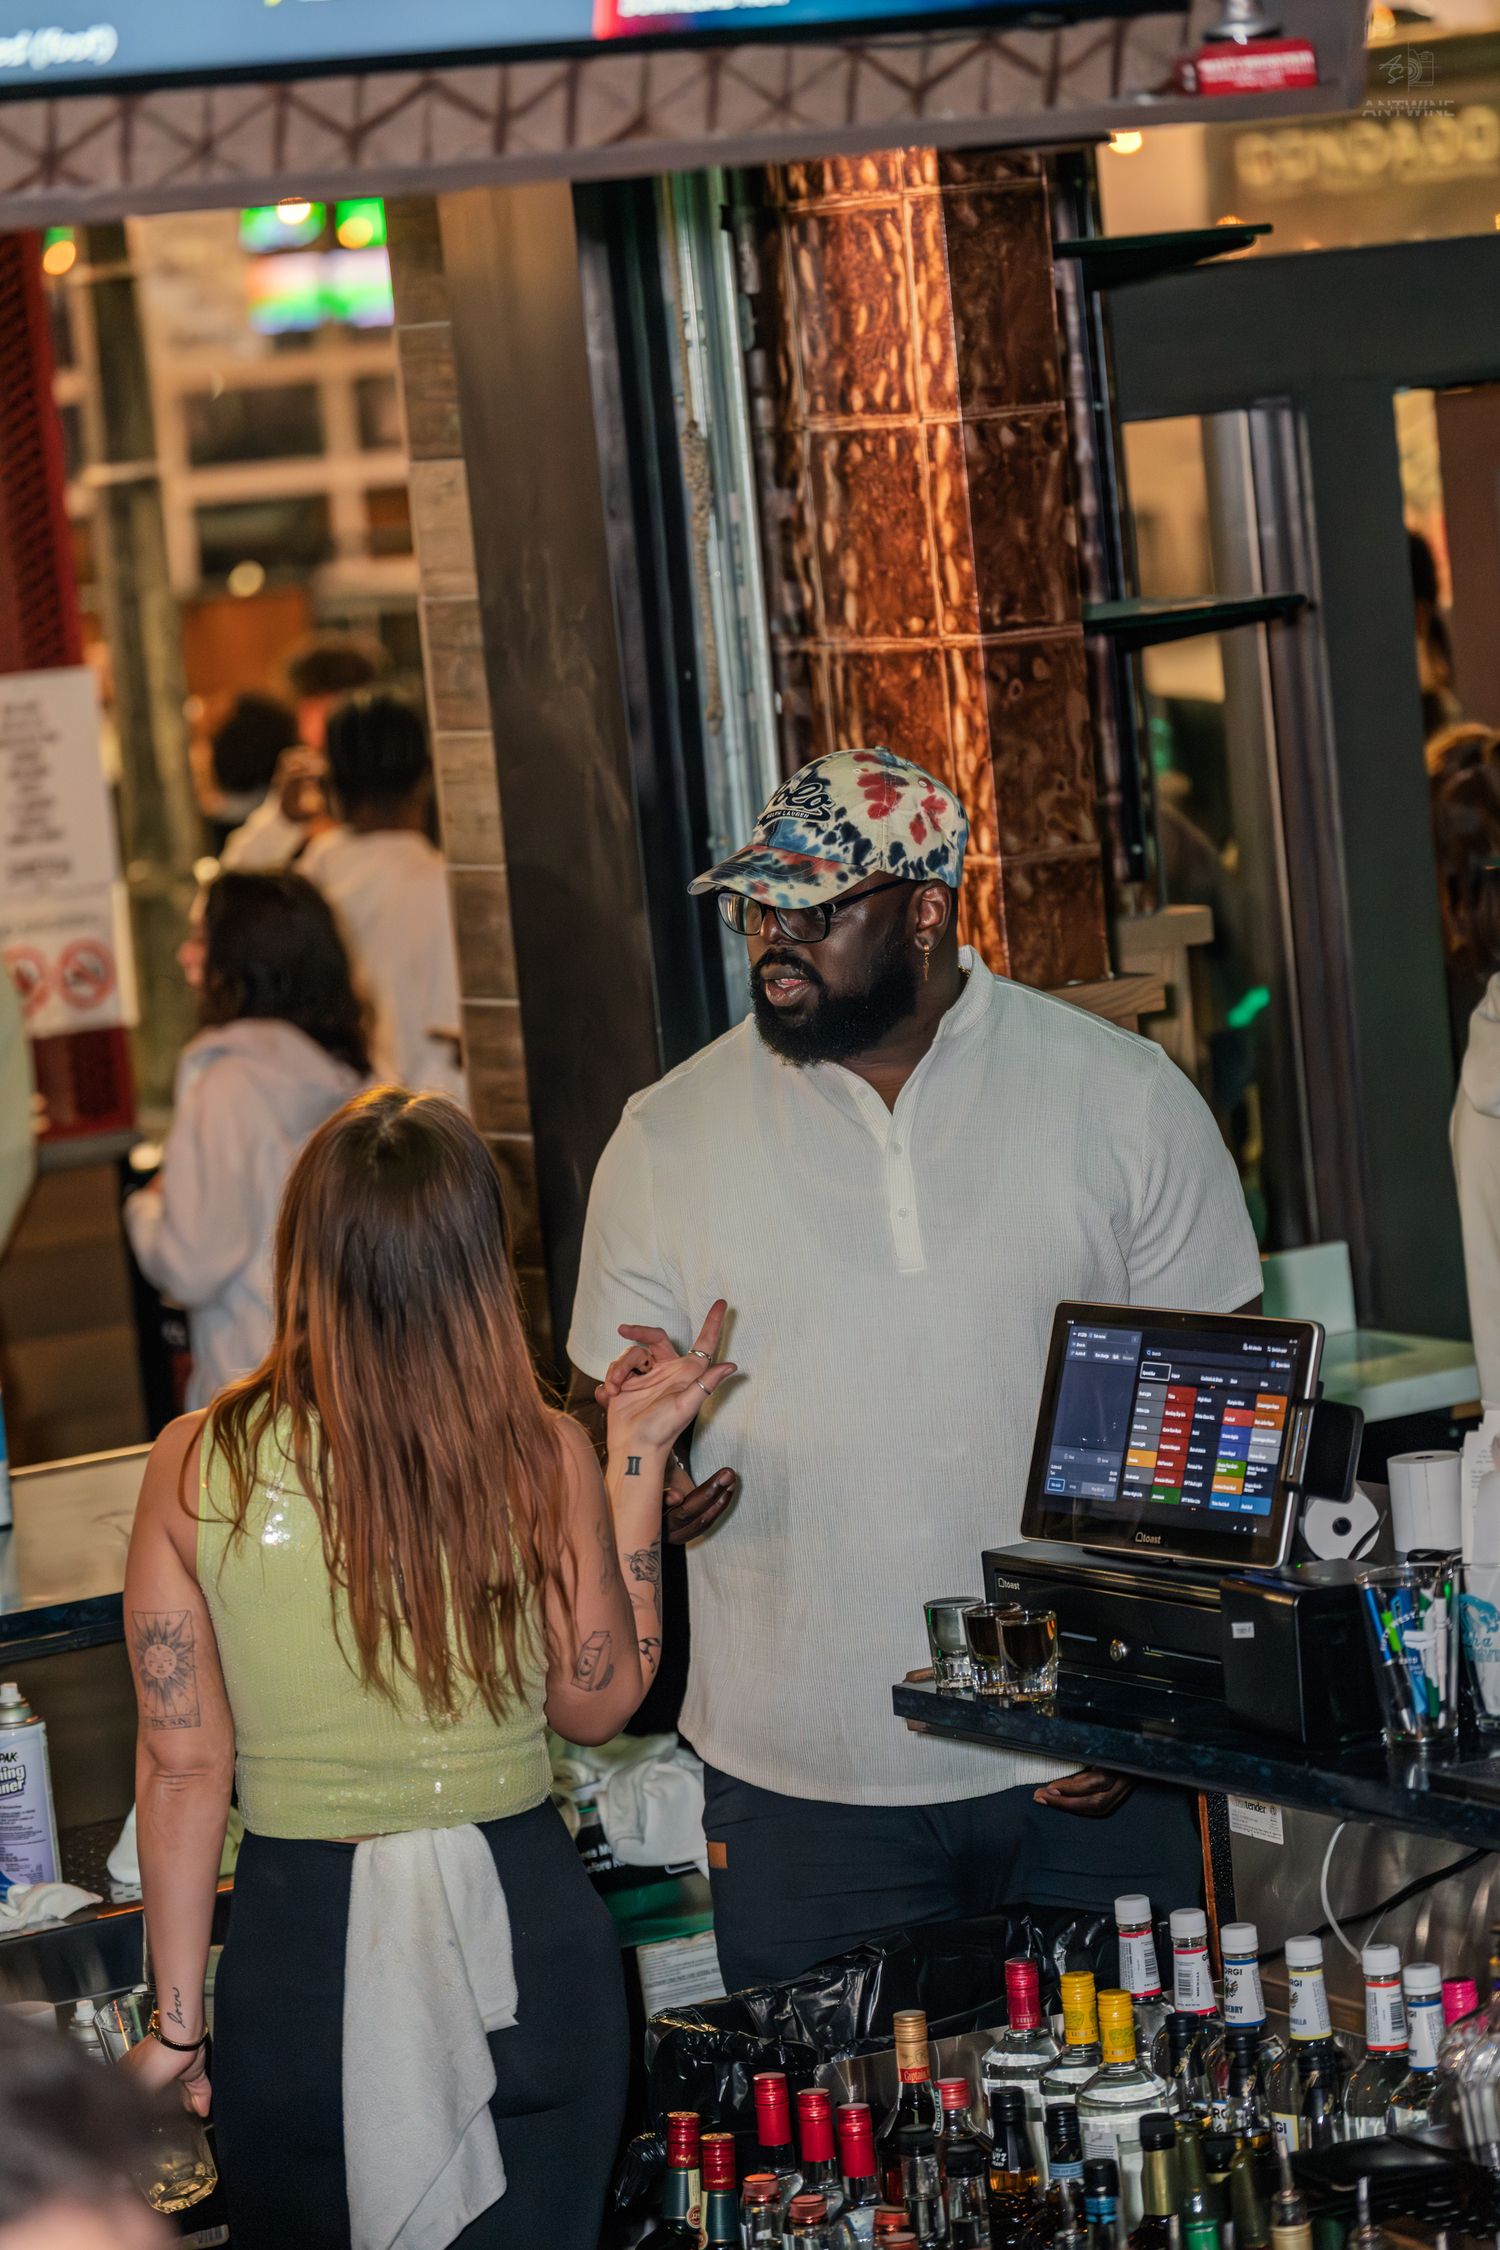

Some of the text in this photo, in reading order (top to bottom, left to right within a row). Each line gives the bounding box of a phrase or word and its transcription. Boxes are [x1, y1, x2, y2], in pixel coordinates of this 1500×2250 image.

[782, 810, 810, 819] LAUREN
[1143, 1533, 1161, 1544] toast
[1004, 1580, 1020, 1590] toast
